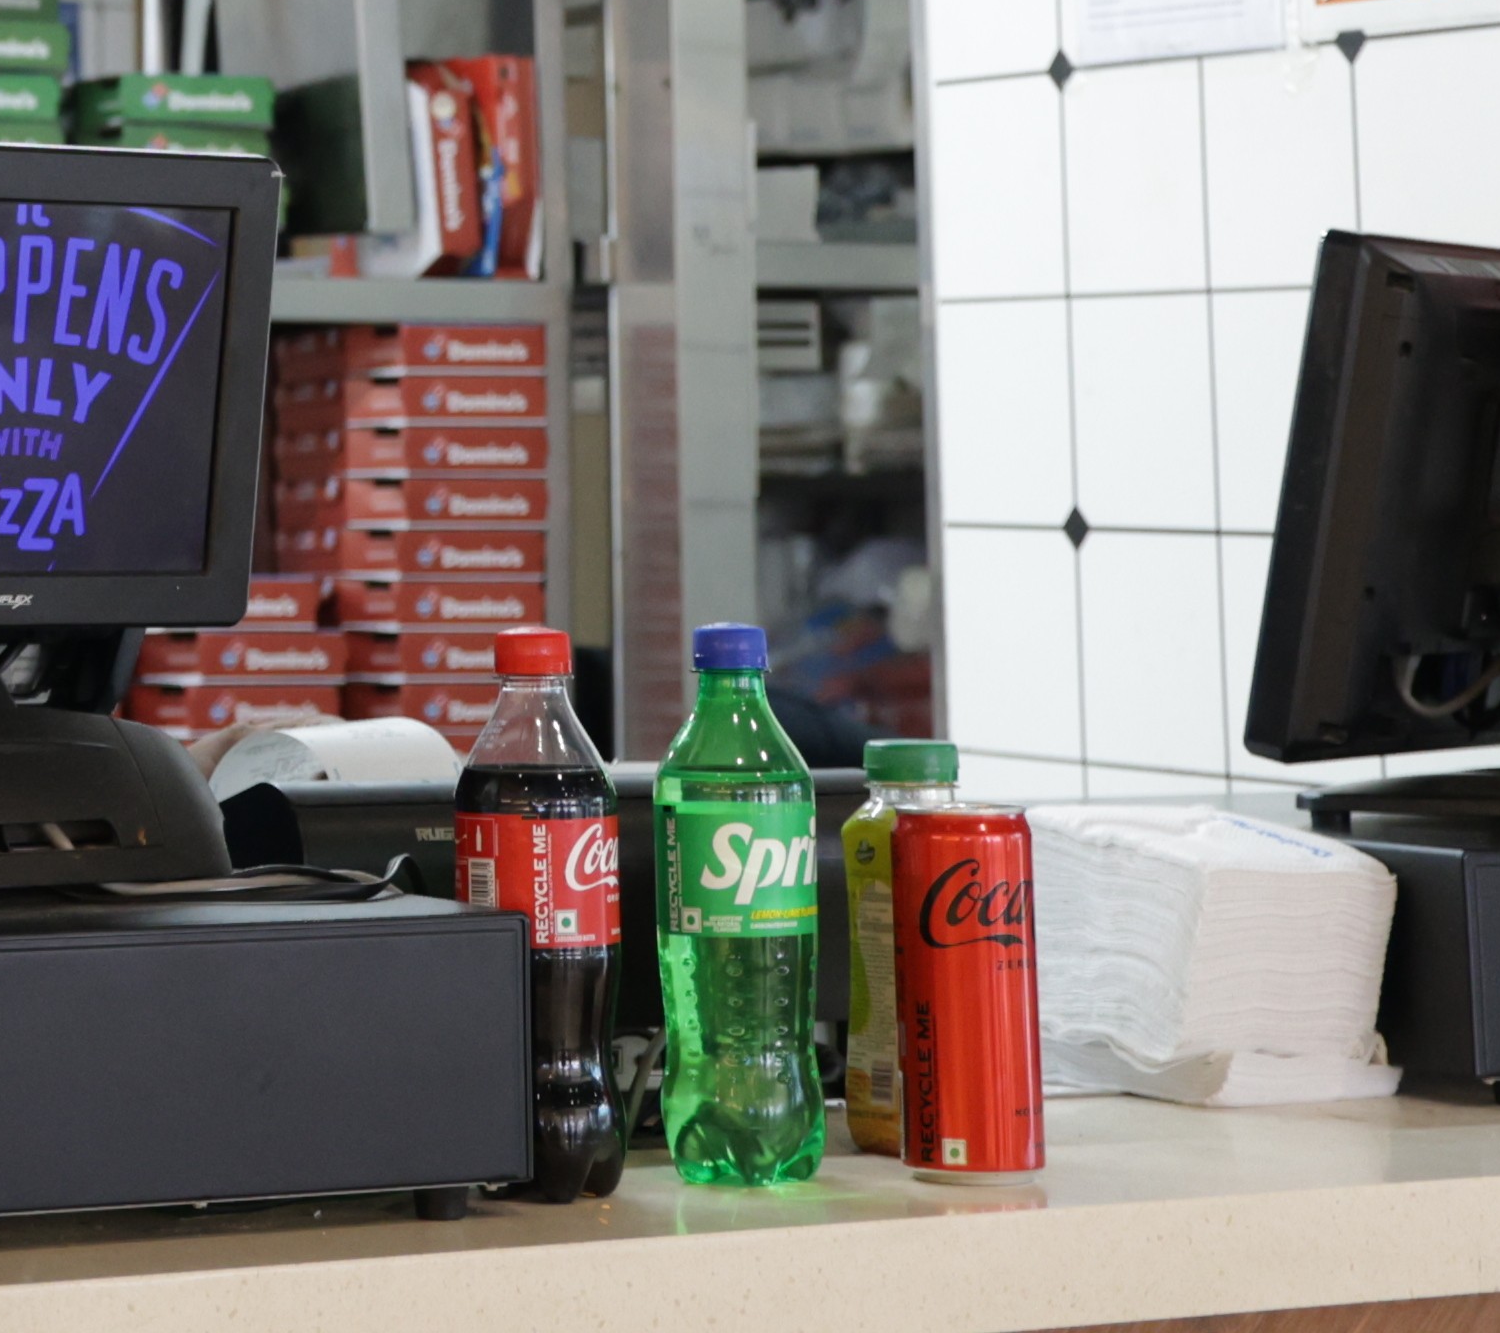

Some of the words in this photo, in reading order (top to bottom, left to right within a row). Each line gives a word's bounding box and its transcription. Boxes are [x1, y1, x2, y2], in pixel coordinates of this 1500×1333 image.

[532, 824, 546, 855] ME
[666, 818, 676, 846] ME
[533, 858, 549, 944] RECYCLE
[667, 850, 680, 931] RECYCLE
[920, 859, 1030, 949] Coca
[915, 1000, 931, 1041] ME
[917, 1051, 934, 1163] RECYCLE
